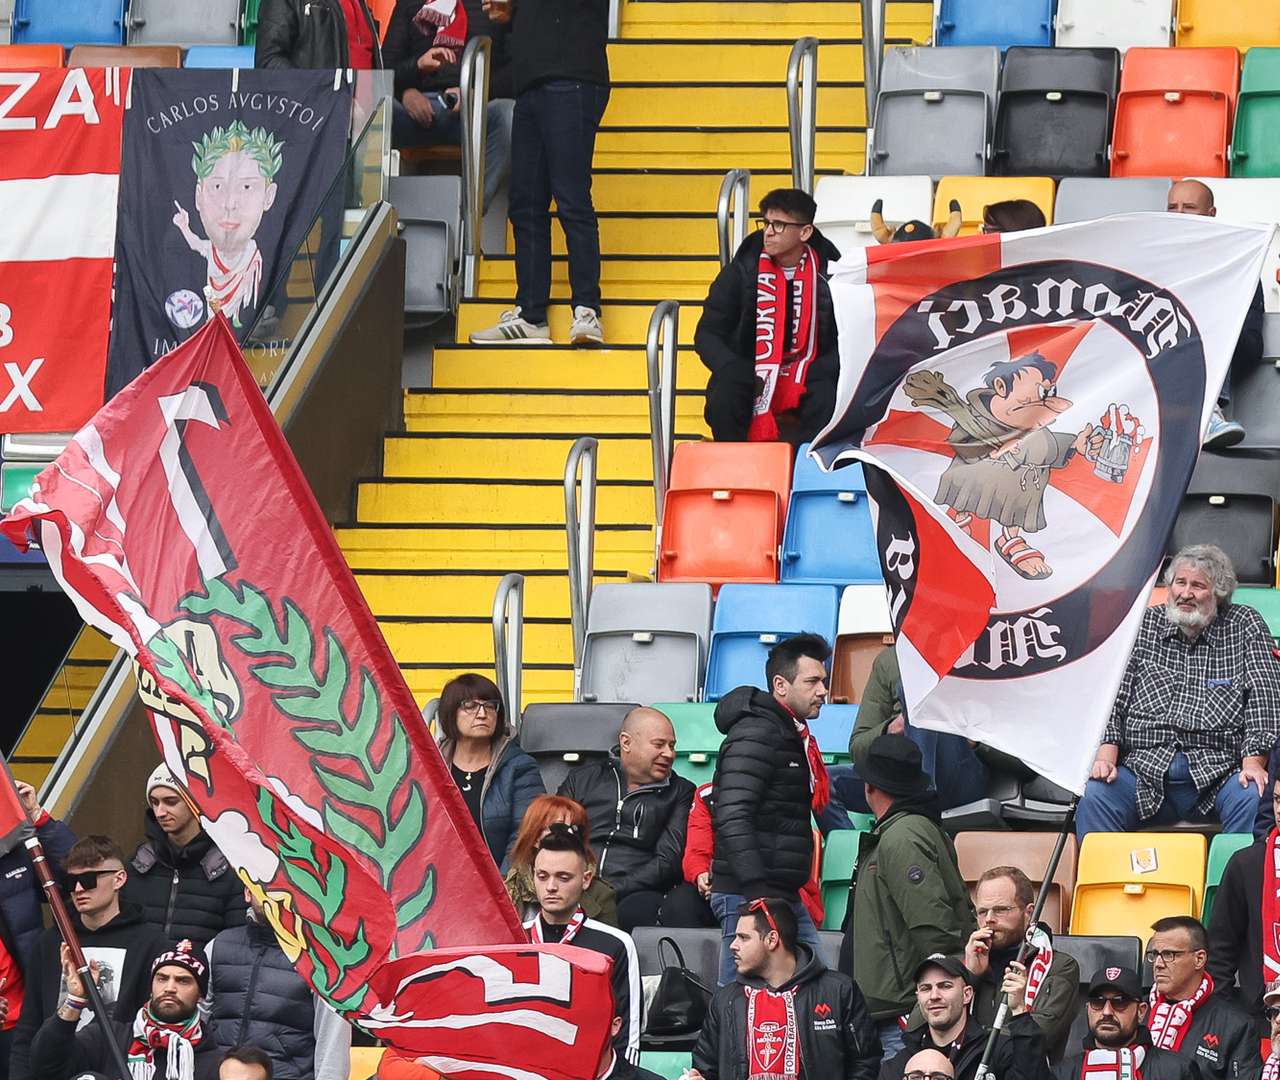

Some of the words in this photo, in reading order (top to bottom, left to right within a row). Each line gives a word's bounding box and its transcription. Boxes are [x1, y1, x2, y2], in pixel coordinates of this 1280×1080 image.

[147, 93, 220, 134] CARLOS
[756, 271, 778, 362] CURVA
[757, 1036, 783, 1045] MONZA
[786, 1011, 795, 1040] BAGAI
[785, 1041, 795, 1072] FORZA
